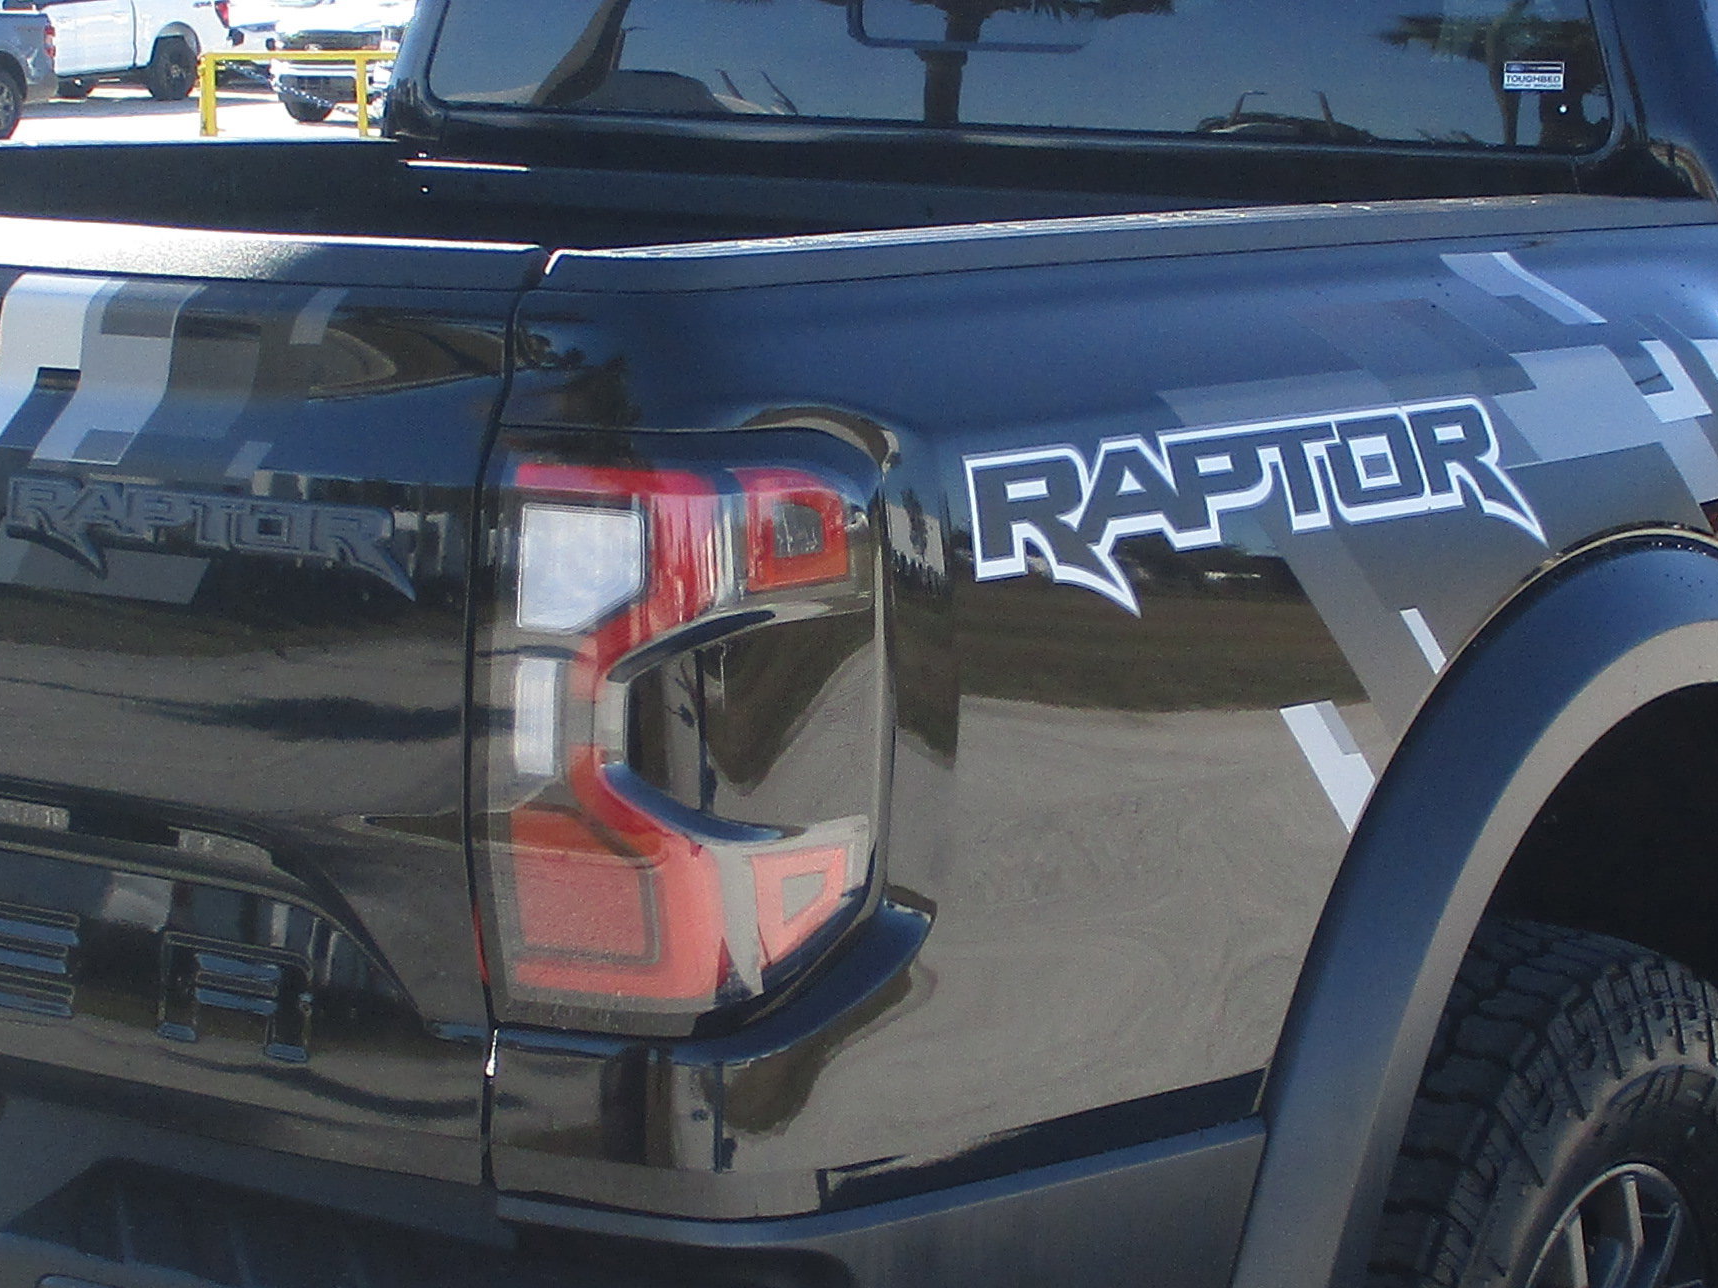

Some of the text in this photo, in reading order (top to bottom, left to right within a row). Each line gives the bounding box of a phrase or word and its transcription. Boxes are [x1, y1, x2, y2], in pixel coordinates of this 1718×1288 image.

[1506, 75, 1561, 83] TOUGHBED
[6, 474, 417, 602] RAPTOR
[961, 395, 1547, 618] RAPTOR
